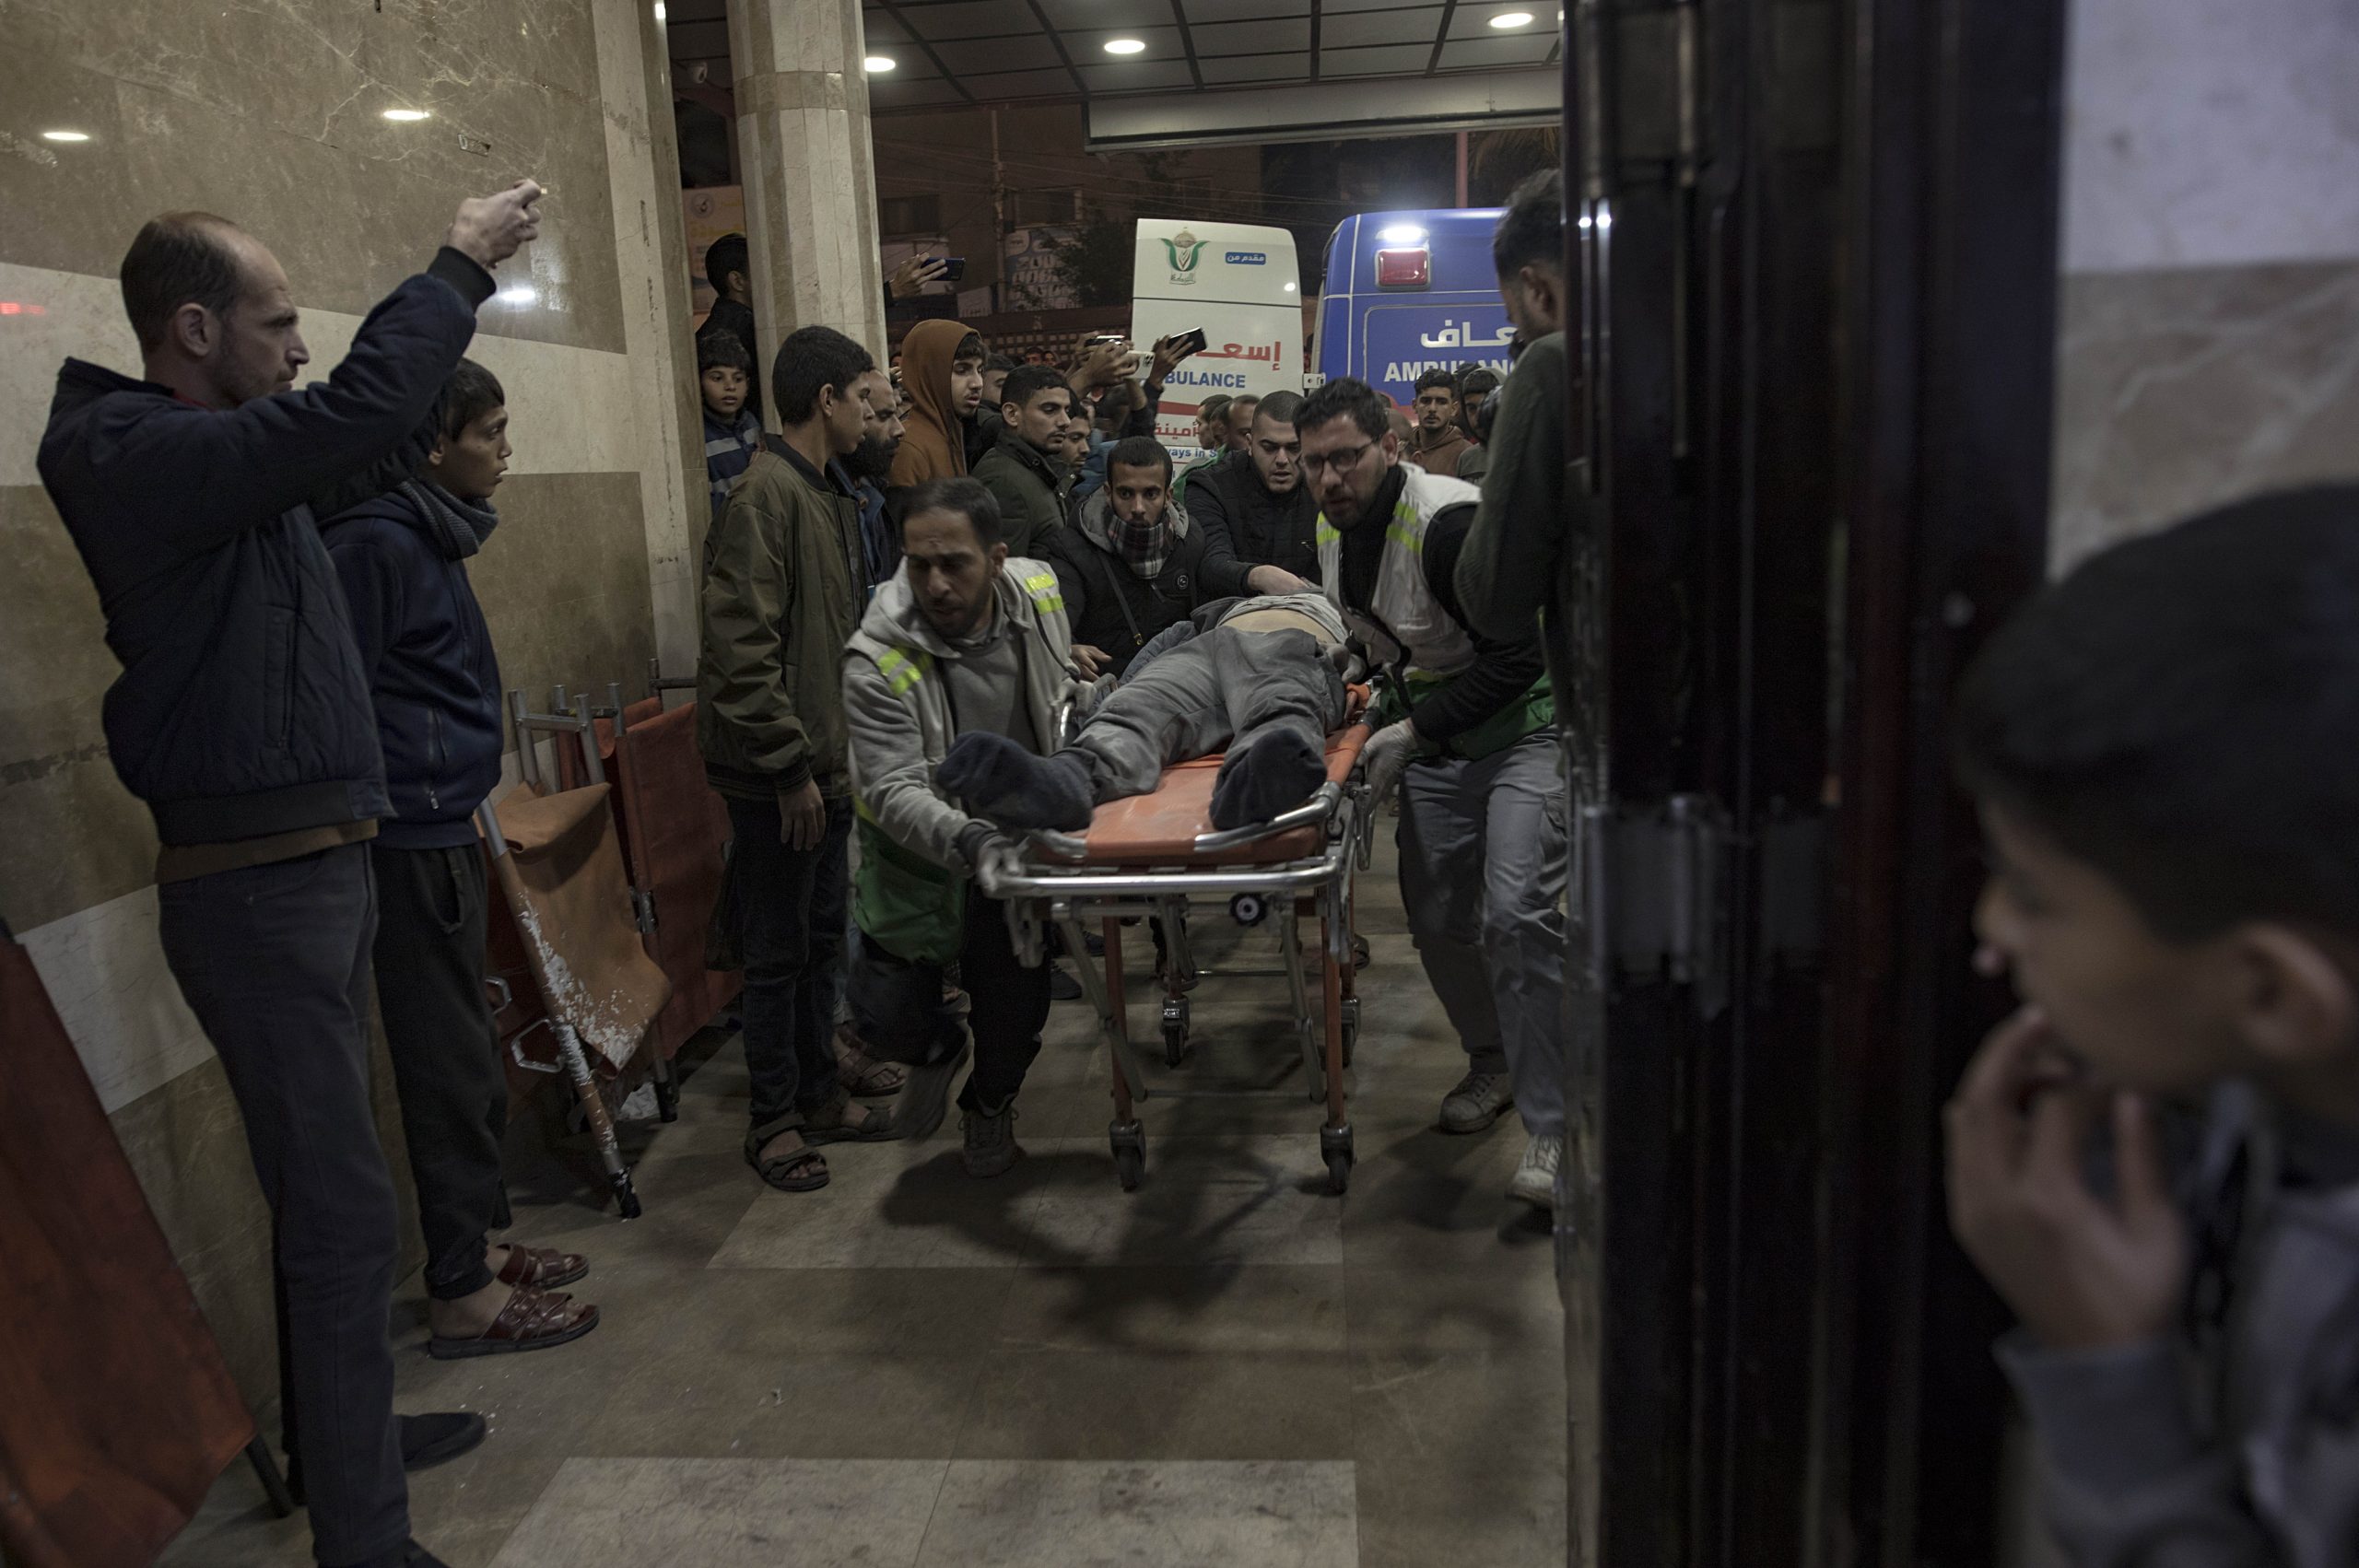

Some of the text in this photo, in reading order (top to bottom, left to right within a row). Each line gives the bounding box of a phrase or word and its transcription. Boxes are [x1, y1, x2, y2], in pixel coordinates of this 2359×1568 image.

[1226, 253, 1265, 263] مقدم من
[1420, 319, 1519, 348] عاف
[1195, 341, 1281, 371] إسع
[1165, 370, 1246, 388] BULANCE
[1154, 420, 1200, 440] أمينة
[1168, 449, 1191, 459] ays
[1194, 448, 1205, 458] in
